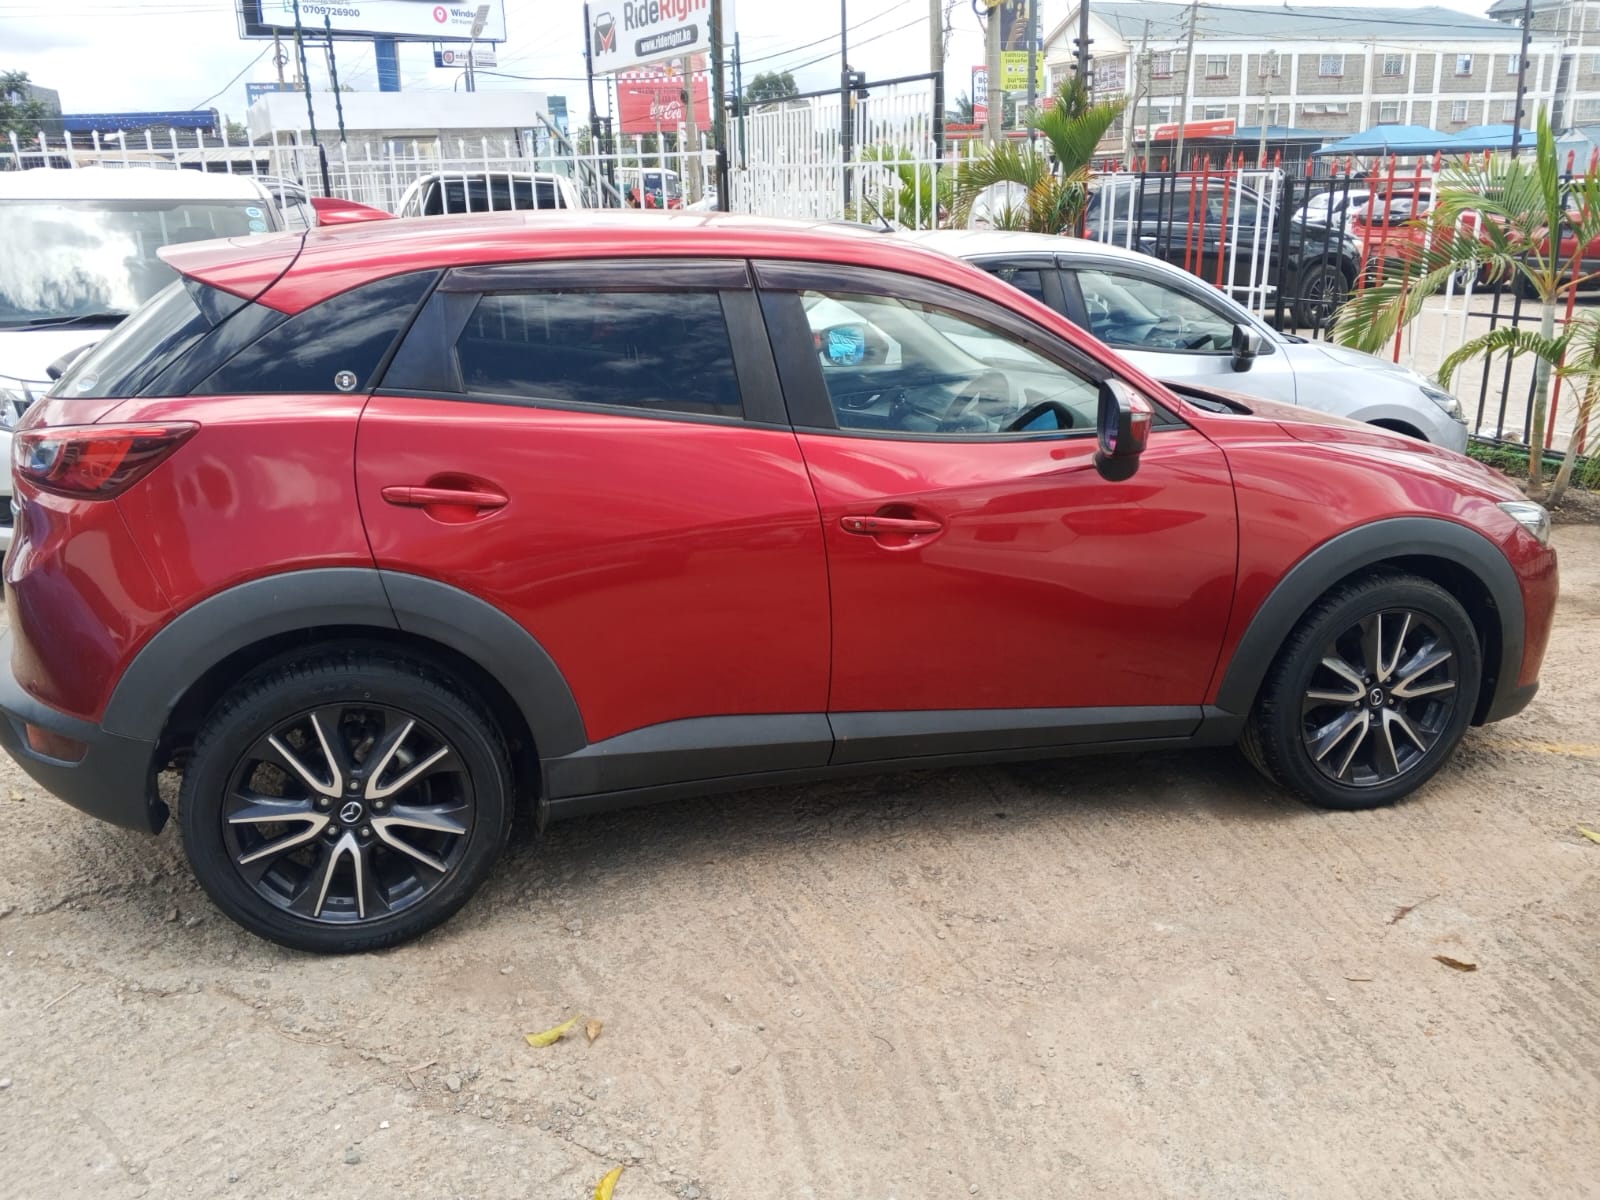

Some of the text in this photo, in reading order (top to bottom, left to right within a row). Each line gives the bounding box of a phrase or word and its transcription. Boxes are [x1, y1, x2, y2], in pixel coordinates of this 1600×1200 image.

[303, 4, 360, 17] 0709726900
[641, 29, 691, 53] www.rideright.ke
[650, 100, 682, 120] Coa-Cola
